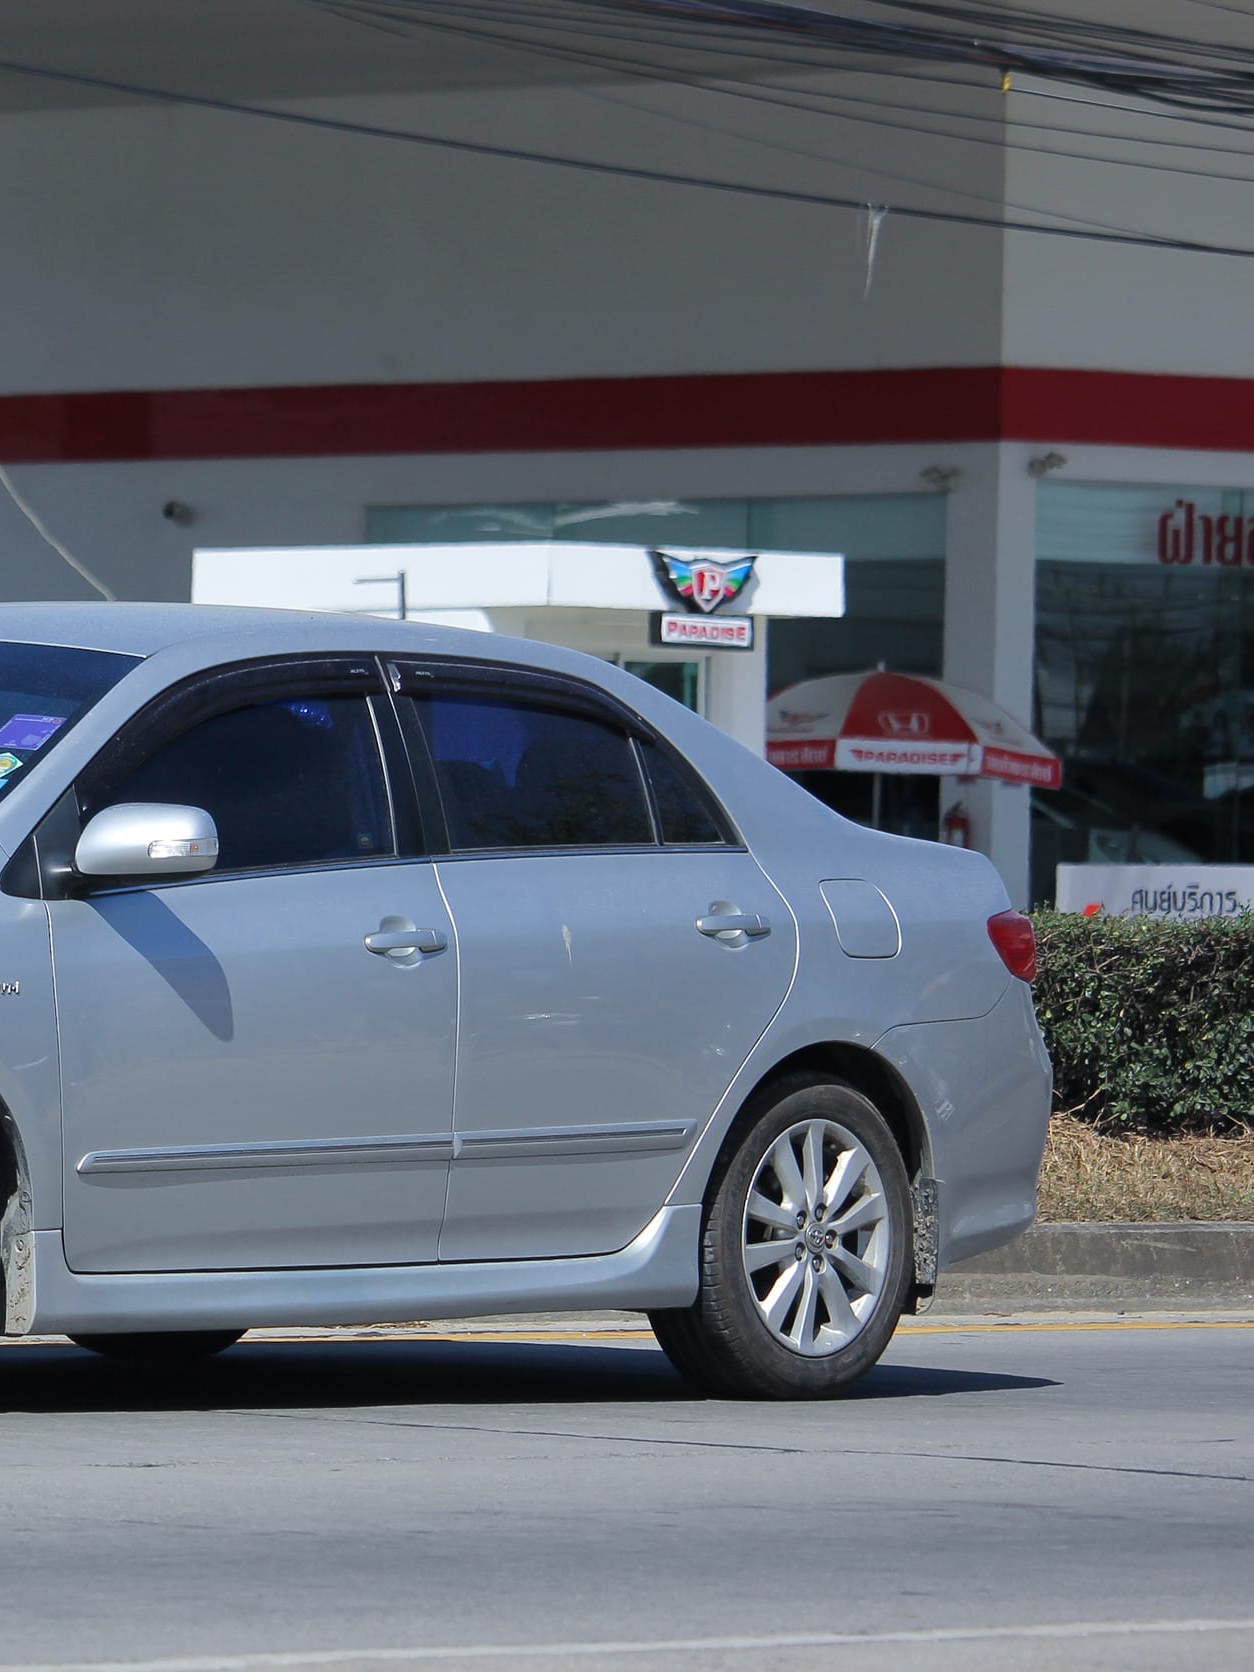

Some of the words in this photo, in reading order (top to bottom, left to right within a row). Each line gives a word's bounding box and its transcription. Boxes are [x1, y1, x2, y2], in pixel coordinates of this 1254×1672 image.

[1157, 497, 1254, 568] ฝ่าย
[667, 621, 747, 641] PARADISE
[863, 750, 948, 766] PARADISE
[1131, 884, 1238, 914] ศนย์บริการ
